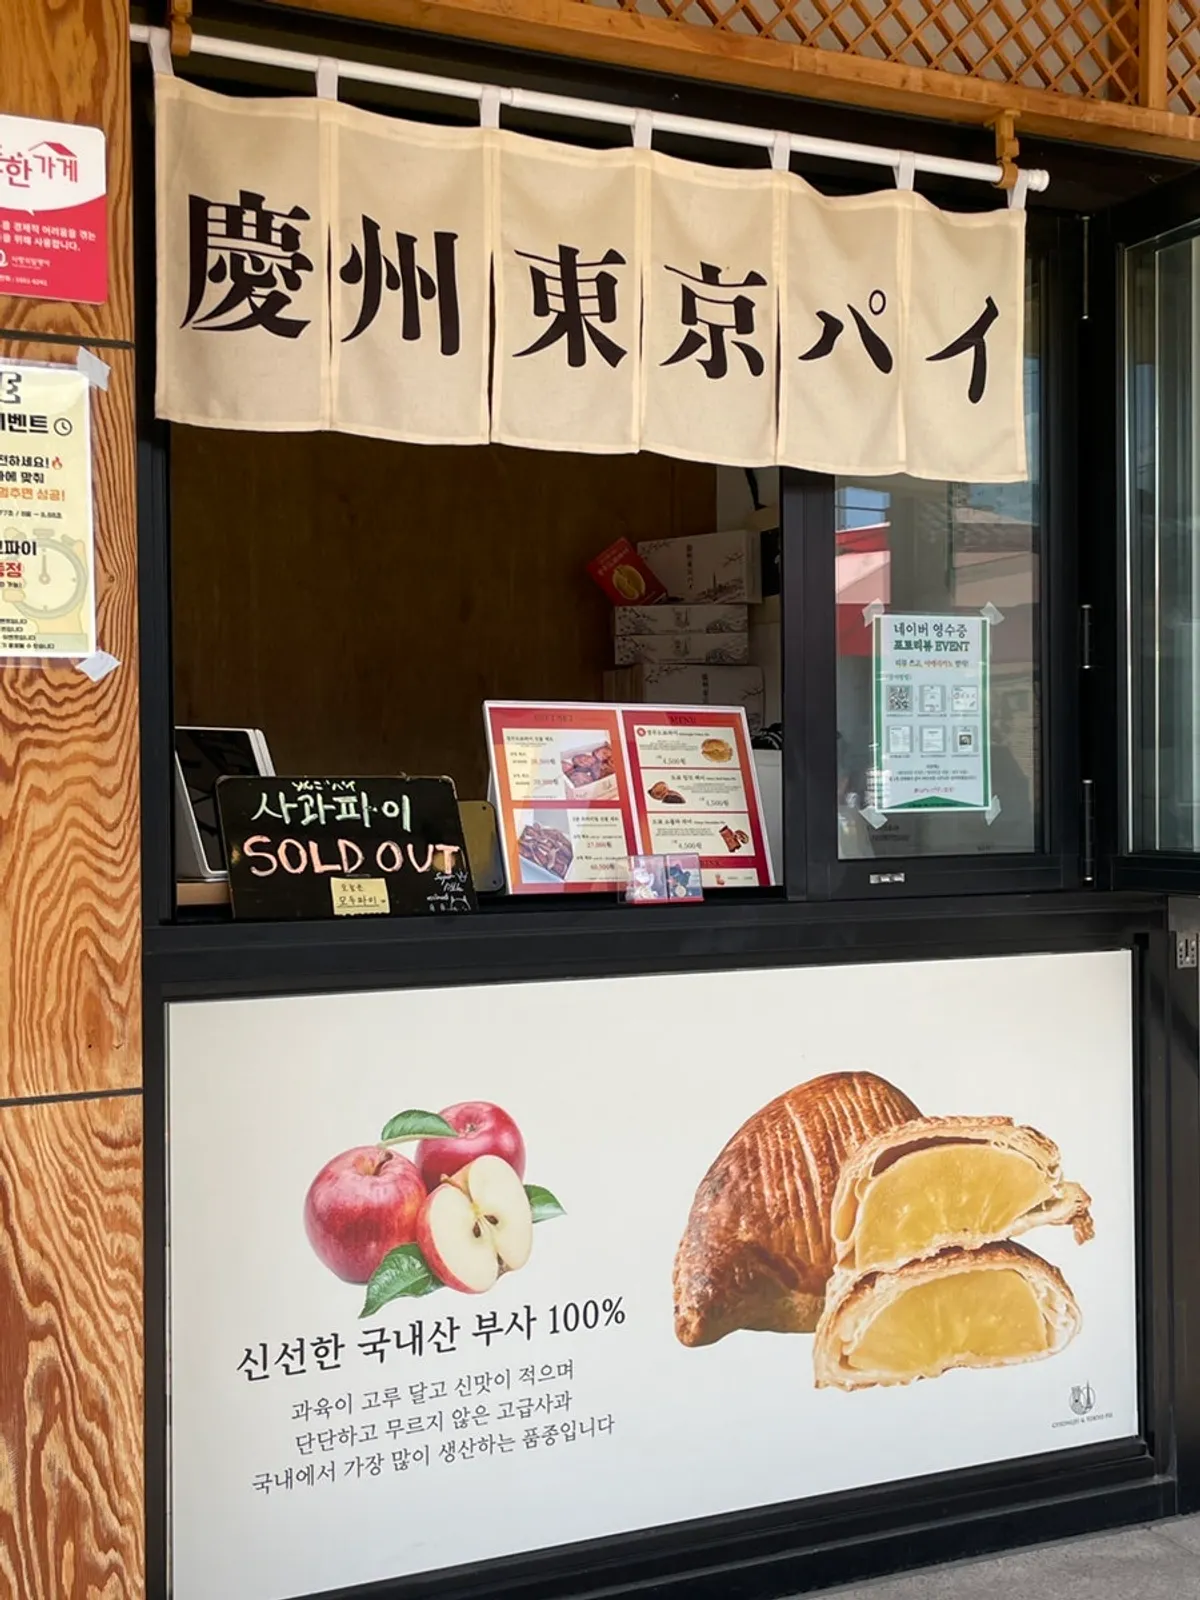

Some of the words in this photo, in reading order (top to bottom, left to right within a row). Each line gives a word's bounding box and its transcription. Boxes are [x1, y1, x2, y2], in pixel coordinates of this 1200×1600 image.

[0, 470, 17, 482] 에
[20, 471, 45, 484] 맞춰
[37, 488, 66, 502] 성공!
[0, 540, 37, 556] 파이
[893, 622, 929, 637] 네이버
[932, 622, 968, 638] 영수증
[935, 641, 970, 652] EVENT
[243, 834, 365, 877] SOLD
[376, 840, 460, 875] OUT
[236, 1333, 345, 1382] 신선한
[357, 1316, 461, 1364] 국내산
[471, 1304, 537, 1347] 부사
[547, 1296, 626, 1336] 100%
[291, 1392, 353, 1422] 과육이
[361, 1385, 402, 1411] 고루
[408, 1379, 448, 1404] 달고
[454, 1368, 512, 1397] 신맛이
[518, 1359, 575, 1387] 적으며
[295, 1421, 379, 1456] 단단하고
[385, 1409, 444, 1439] 무르지
[451, 1402, 491, 1429] 않은
[496, 1390, 573, 1421] 고급사과
[252, 1460, 336, 1494] 국내에서
[344, 1453, 385, 1479] 가장
[391, 1444, 430, 1471] 많이
[438, 1431, 516, 1463] 생산하는
[522, 1414, 616, 1451] 품종입니다
